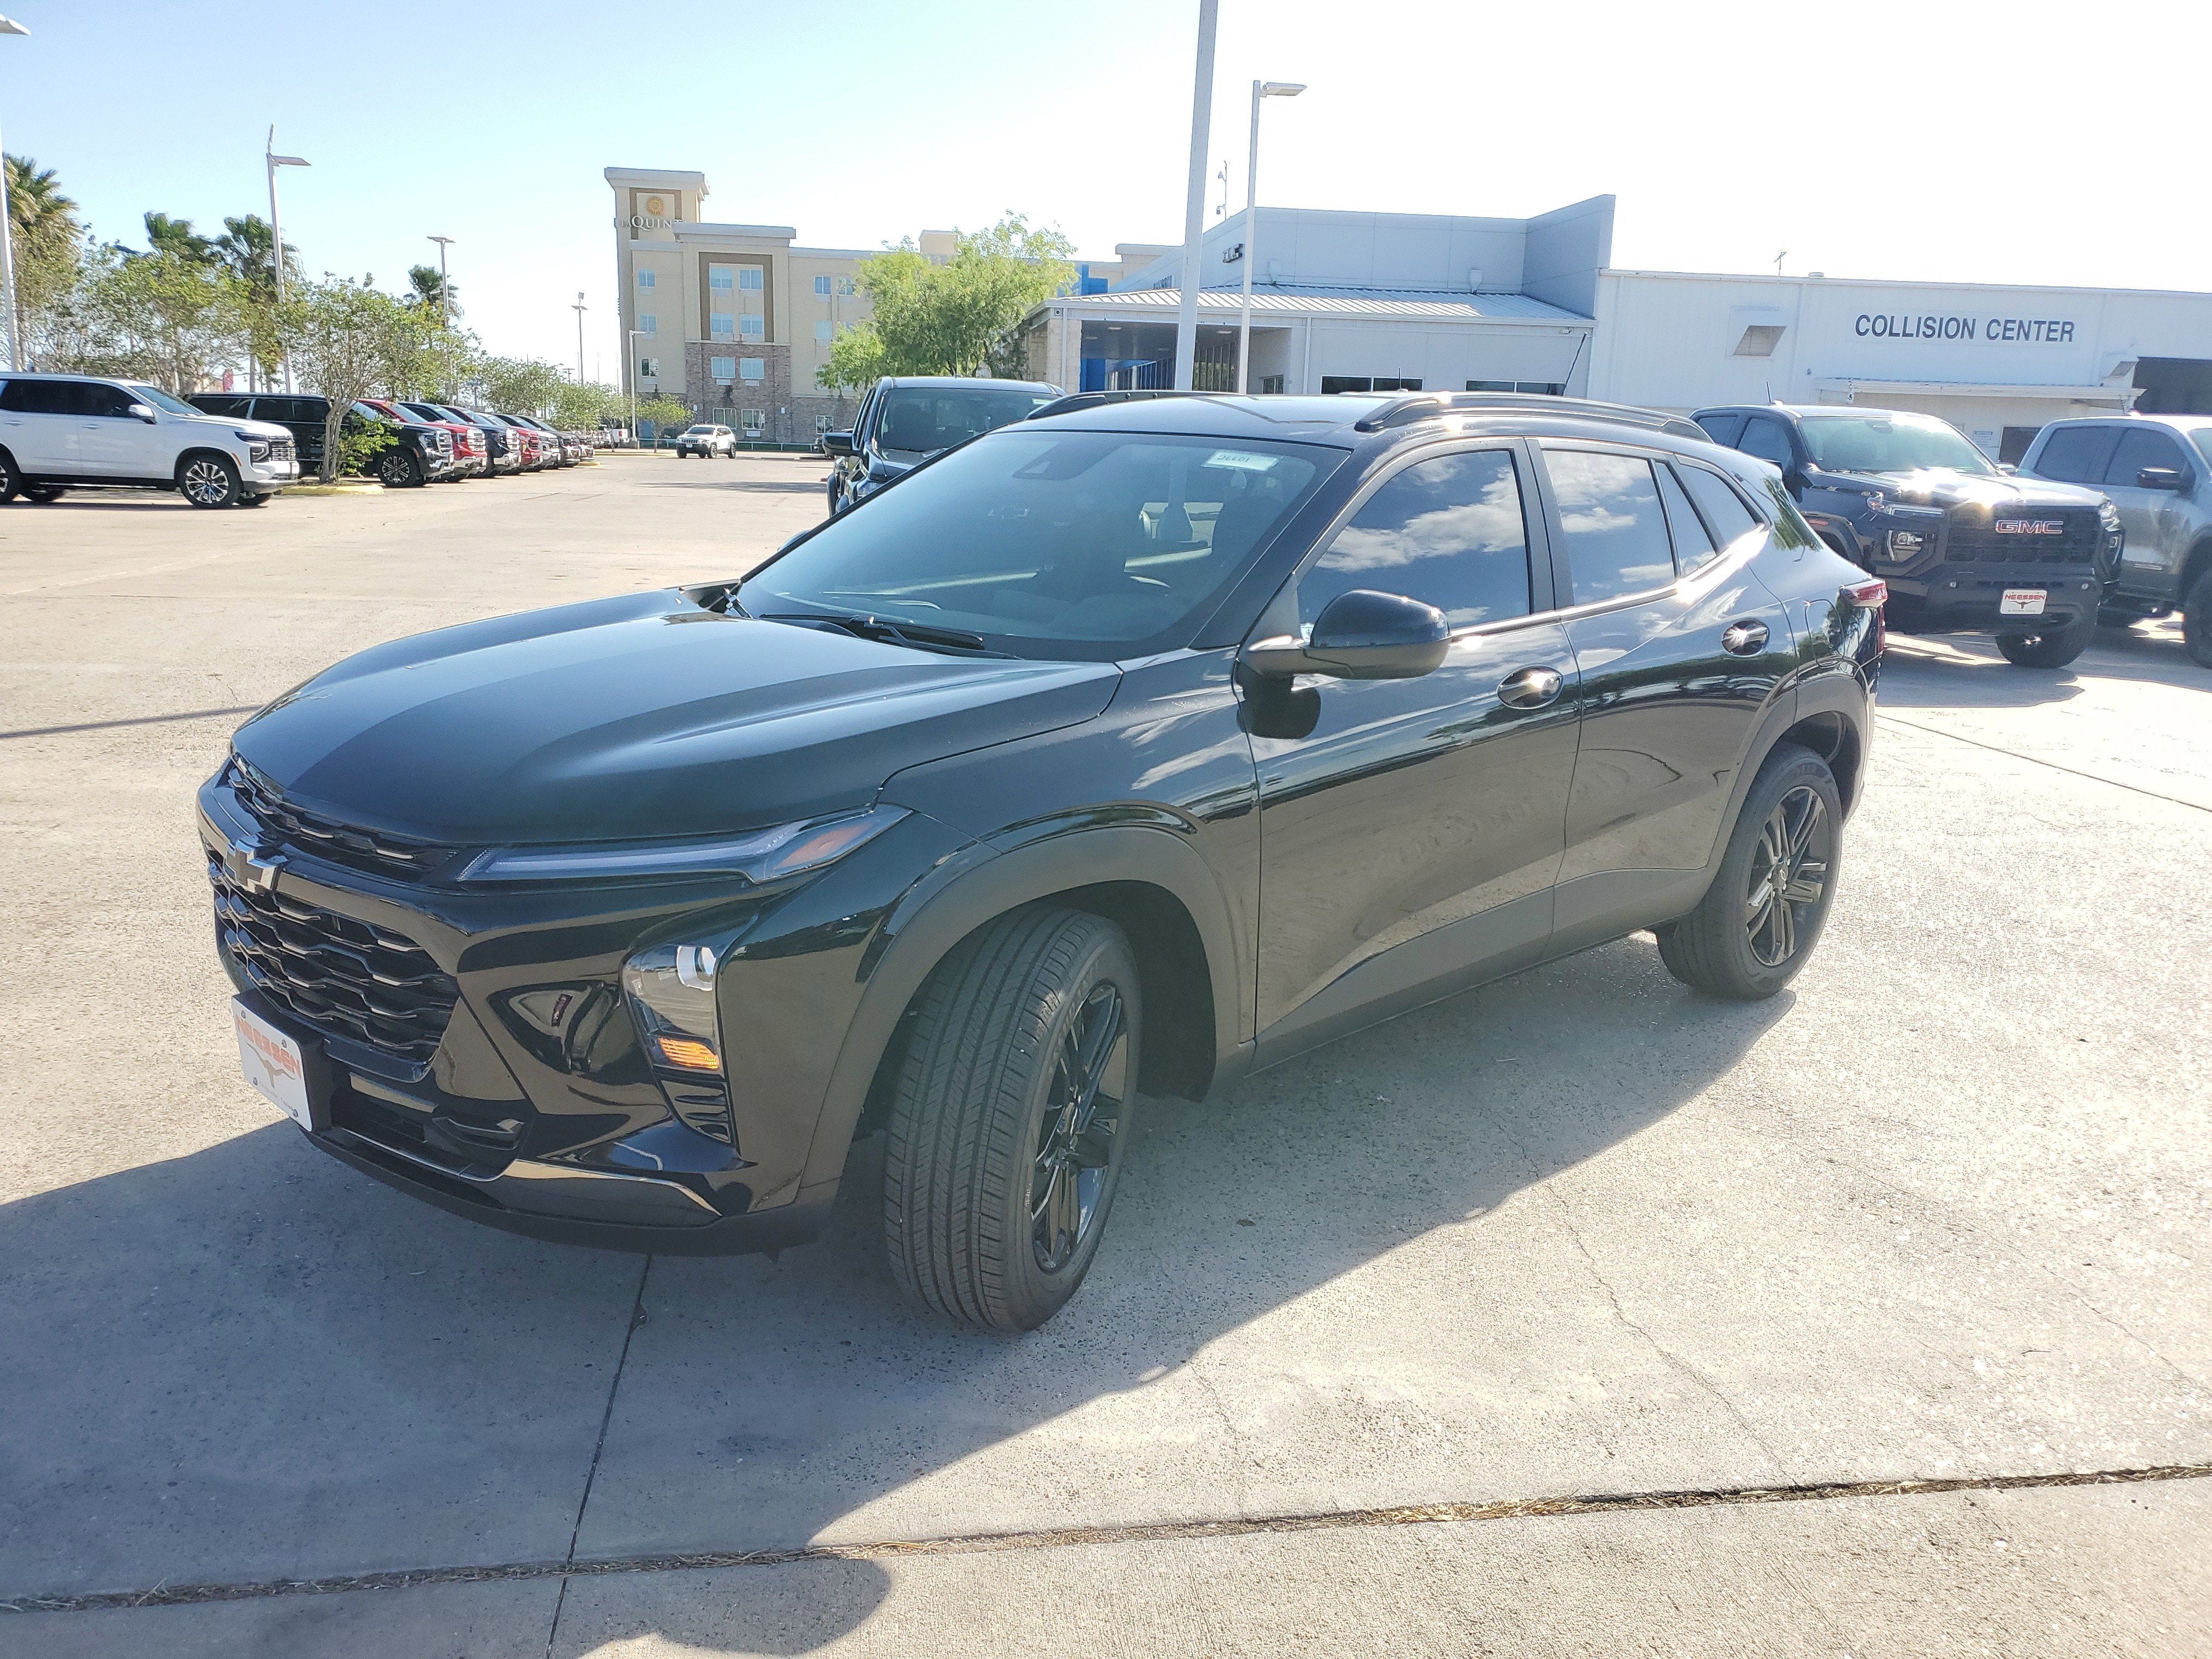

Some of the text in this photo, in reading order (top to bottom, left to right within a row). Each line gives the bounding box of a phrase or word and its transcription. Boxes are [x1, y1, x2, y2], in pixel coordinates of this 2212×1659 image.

[1855, 314, 2075, 342] COLLISION CENTER
[1995, 520, 2064, 534] GMC
